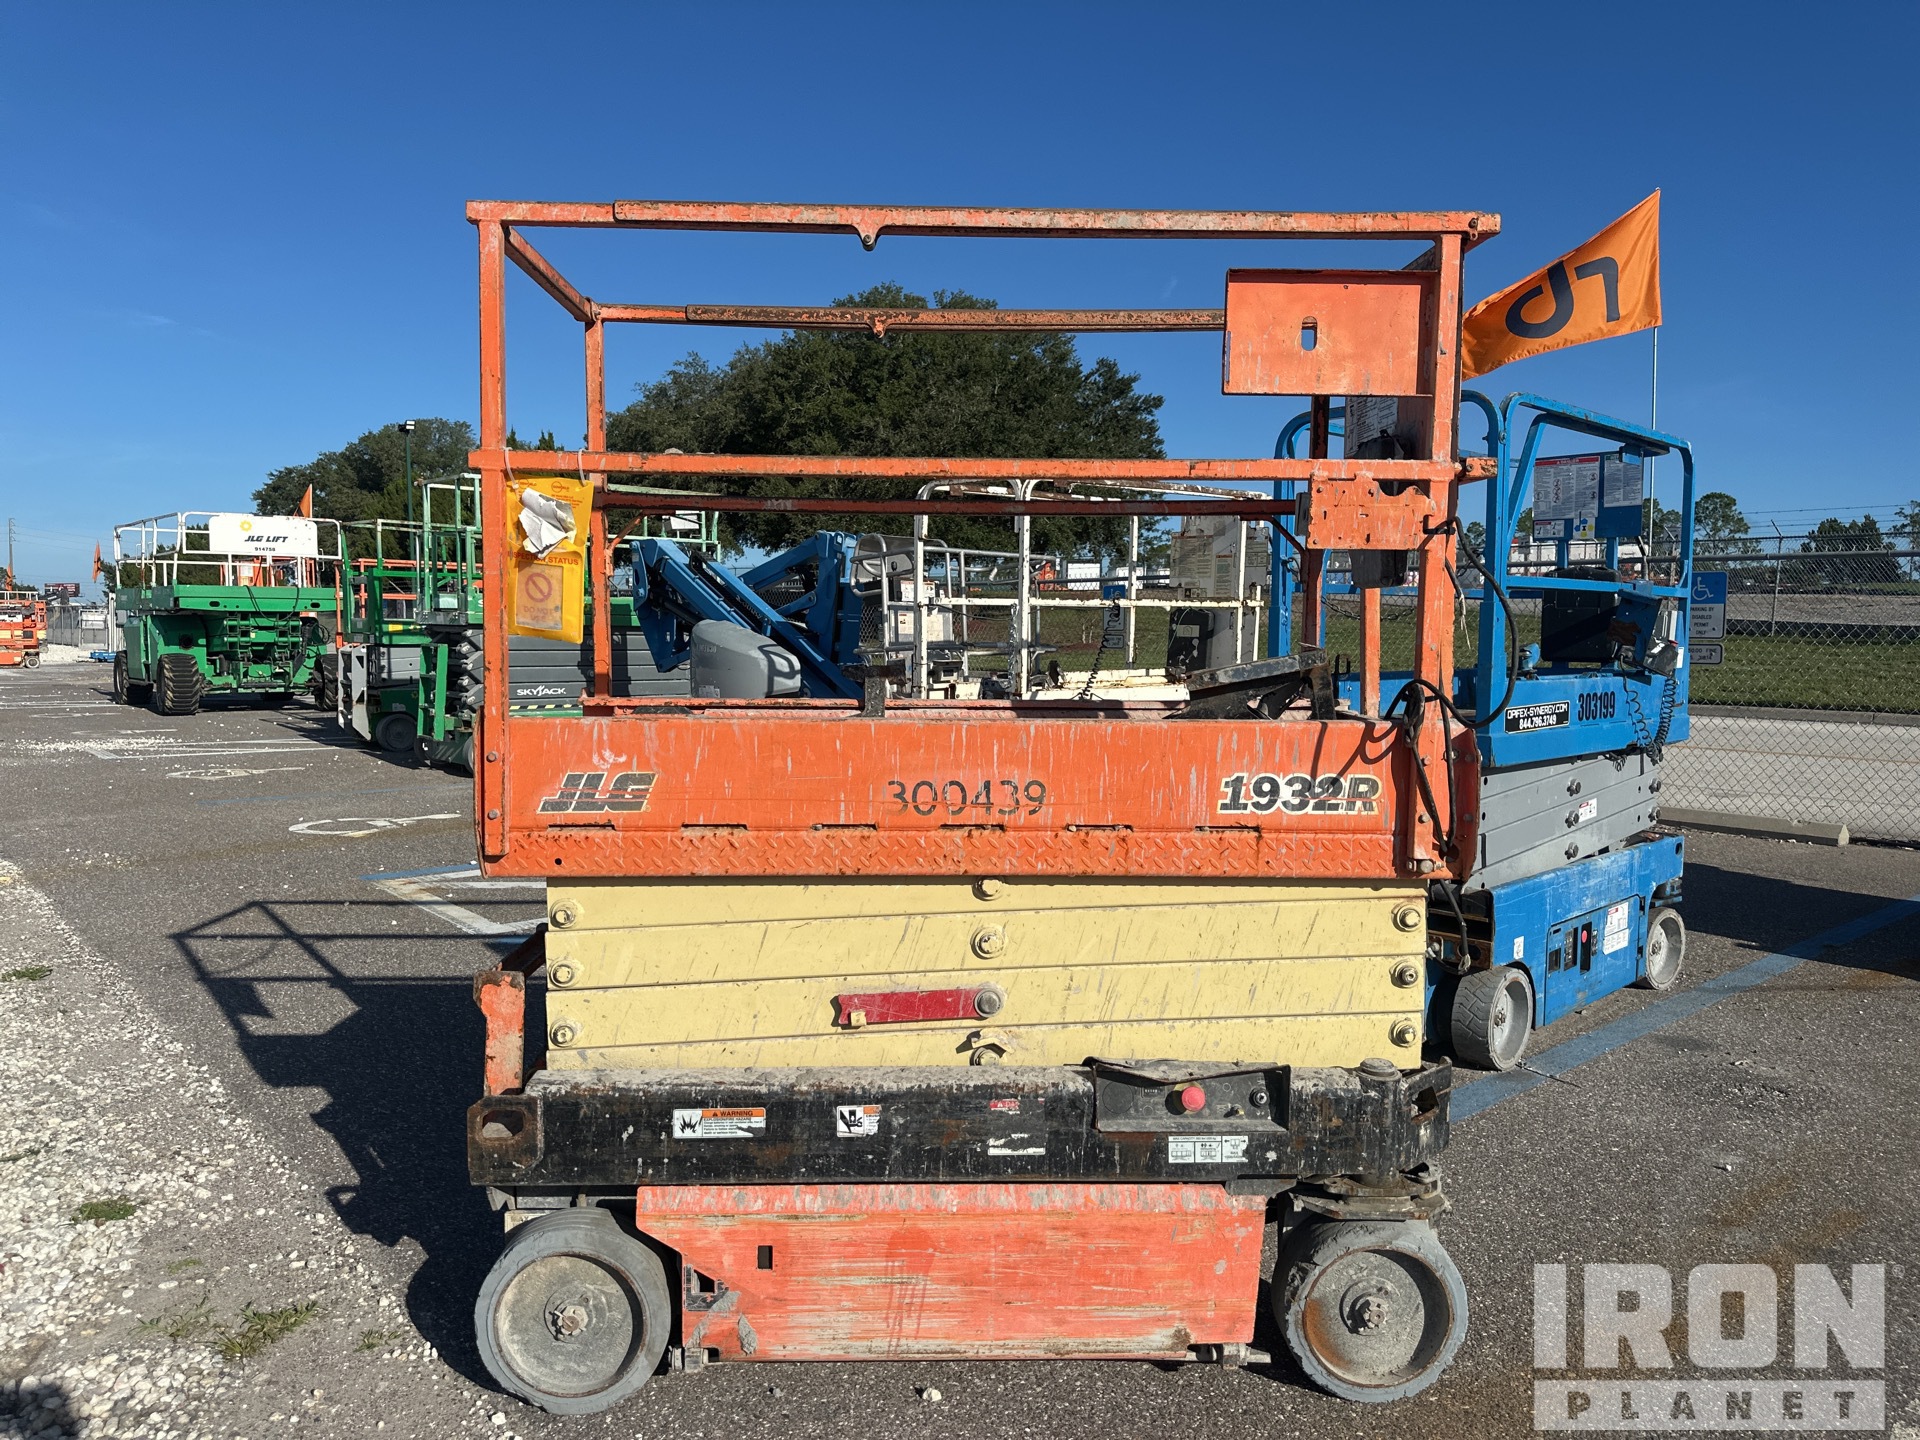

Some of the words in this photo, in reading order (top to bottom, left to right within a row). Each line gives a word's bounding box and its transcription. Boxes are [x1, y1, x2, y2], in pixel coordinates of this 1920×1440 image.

[548, 556, 579, 566] STATUS
[516, 685, 566, 697] SKYJACK
[1577, 691, 1616, 721] 303199
[536, 772, 658, 814] JLG
[887, 780, 1046, 816] 300439
[1217, 772, 1383, 816] 1932R
